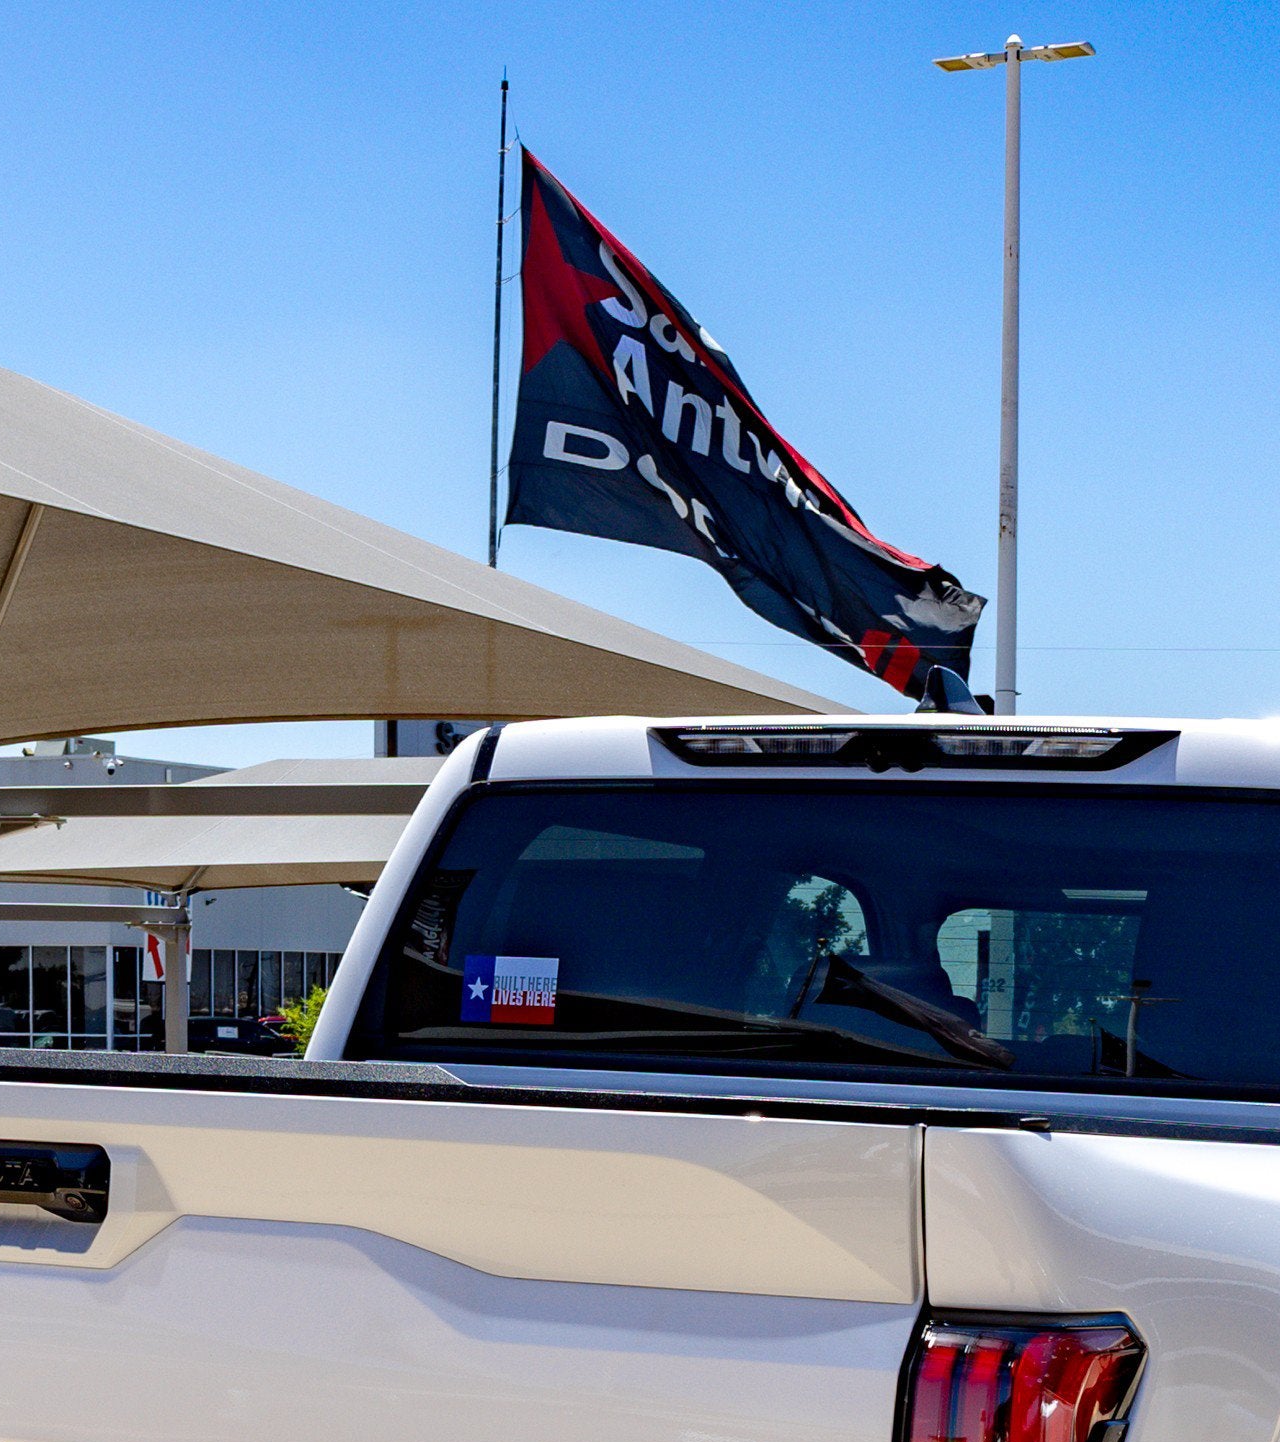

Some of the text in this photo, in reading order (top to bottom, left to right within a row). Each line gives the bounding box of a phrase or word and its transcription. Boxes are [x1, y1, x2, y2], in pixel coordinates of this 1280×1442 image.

[494, 975, 558, 992] BUILT HERE
[491, 989, 556, 1008] LIVES HERE
